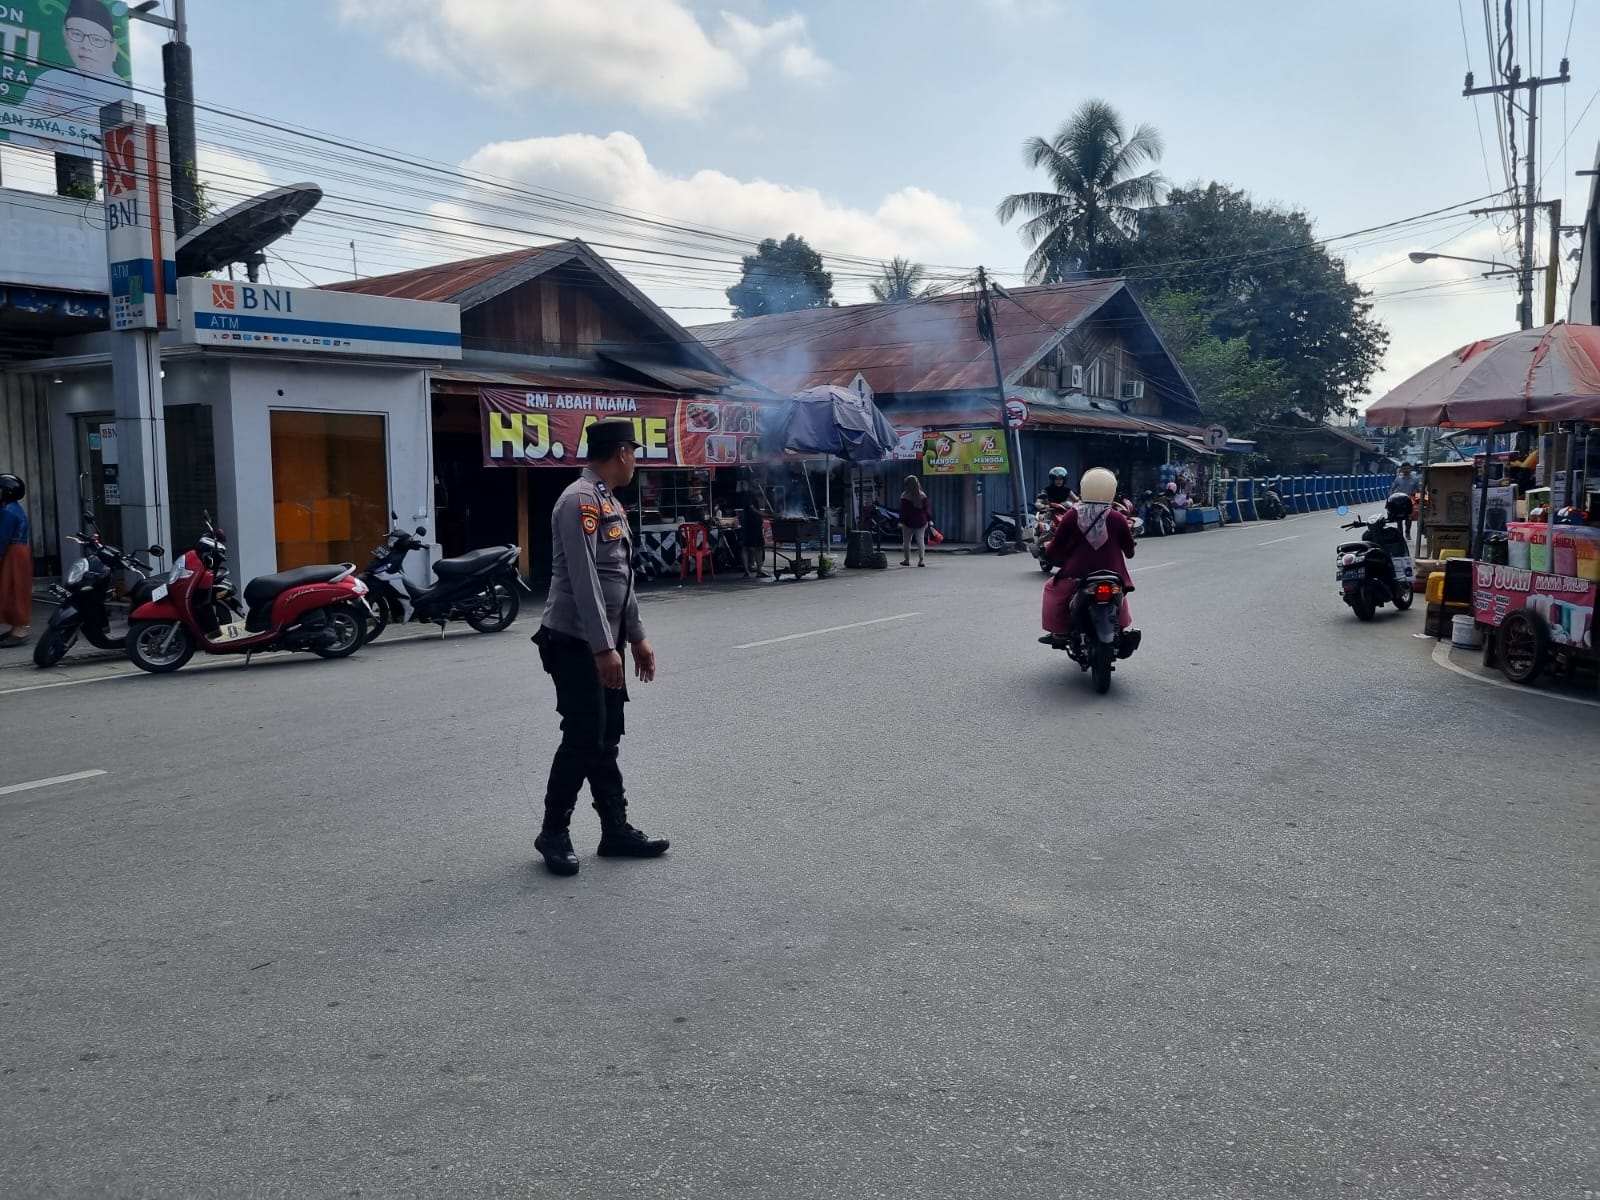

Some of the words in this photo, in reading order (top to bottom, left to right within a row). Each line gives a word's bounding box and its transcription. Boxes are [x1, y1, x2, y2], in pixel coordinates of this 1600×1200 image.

[109, 199, 138, 230] BNI
[241, 287, 292, 312] BNI
[211, 316, 239, 330] ATM
[525, 393, 552, 408] RM.
[556, 395, 592, 410] ABAH
[596, 397, 637, 411] MAMA
[489, 412, 565, 459] HJ.
[575, 415, 669, 459] AIE
